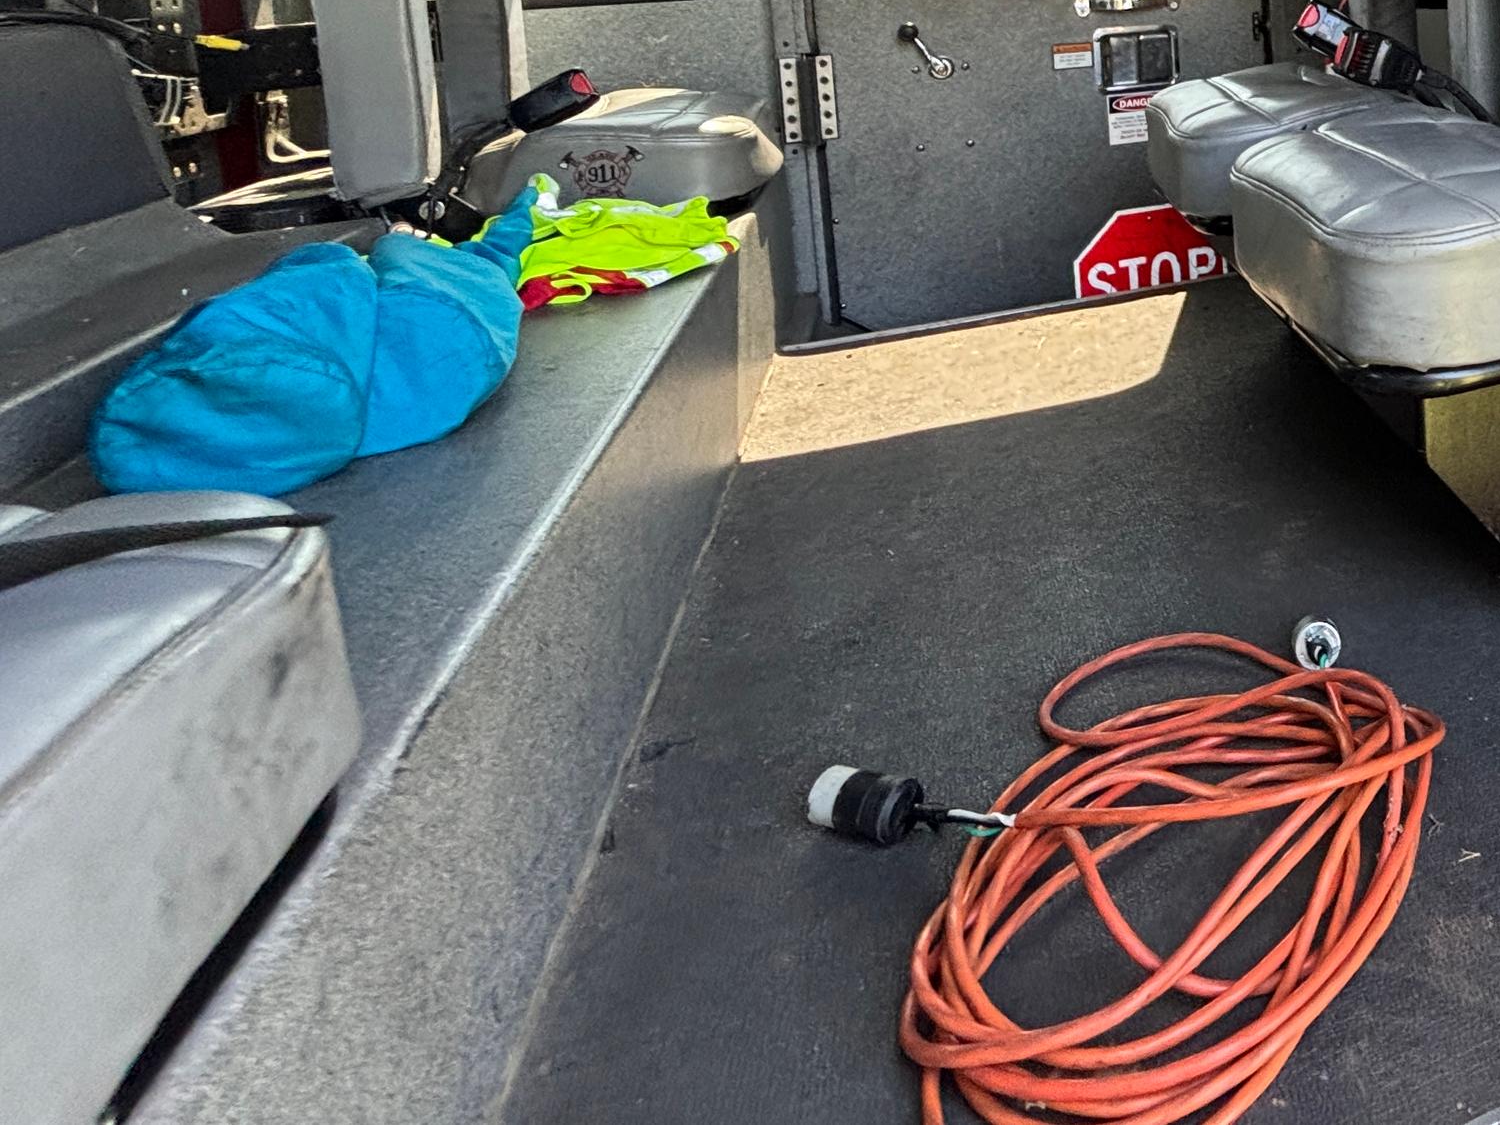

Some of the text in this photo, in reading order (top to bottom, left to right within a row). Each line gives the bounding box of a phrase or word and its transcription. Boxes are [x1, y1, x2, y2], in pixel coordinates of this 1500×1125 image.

[1119, 97, 1152, 109] DANG
[588, 164, 617, 183] 911
[1087, 246, 1217, 295] STOP
